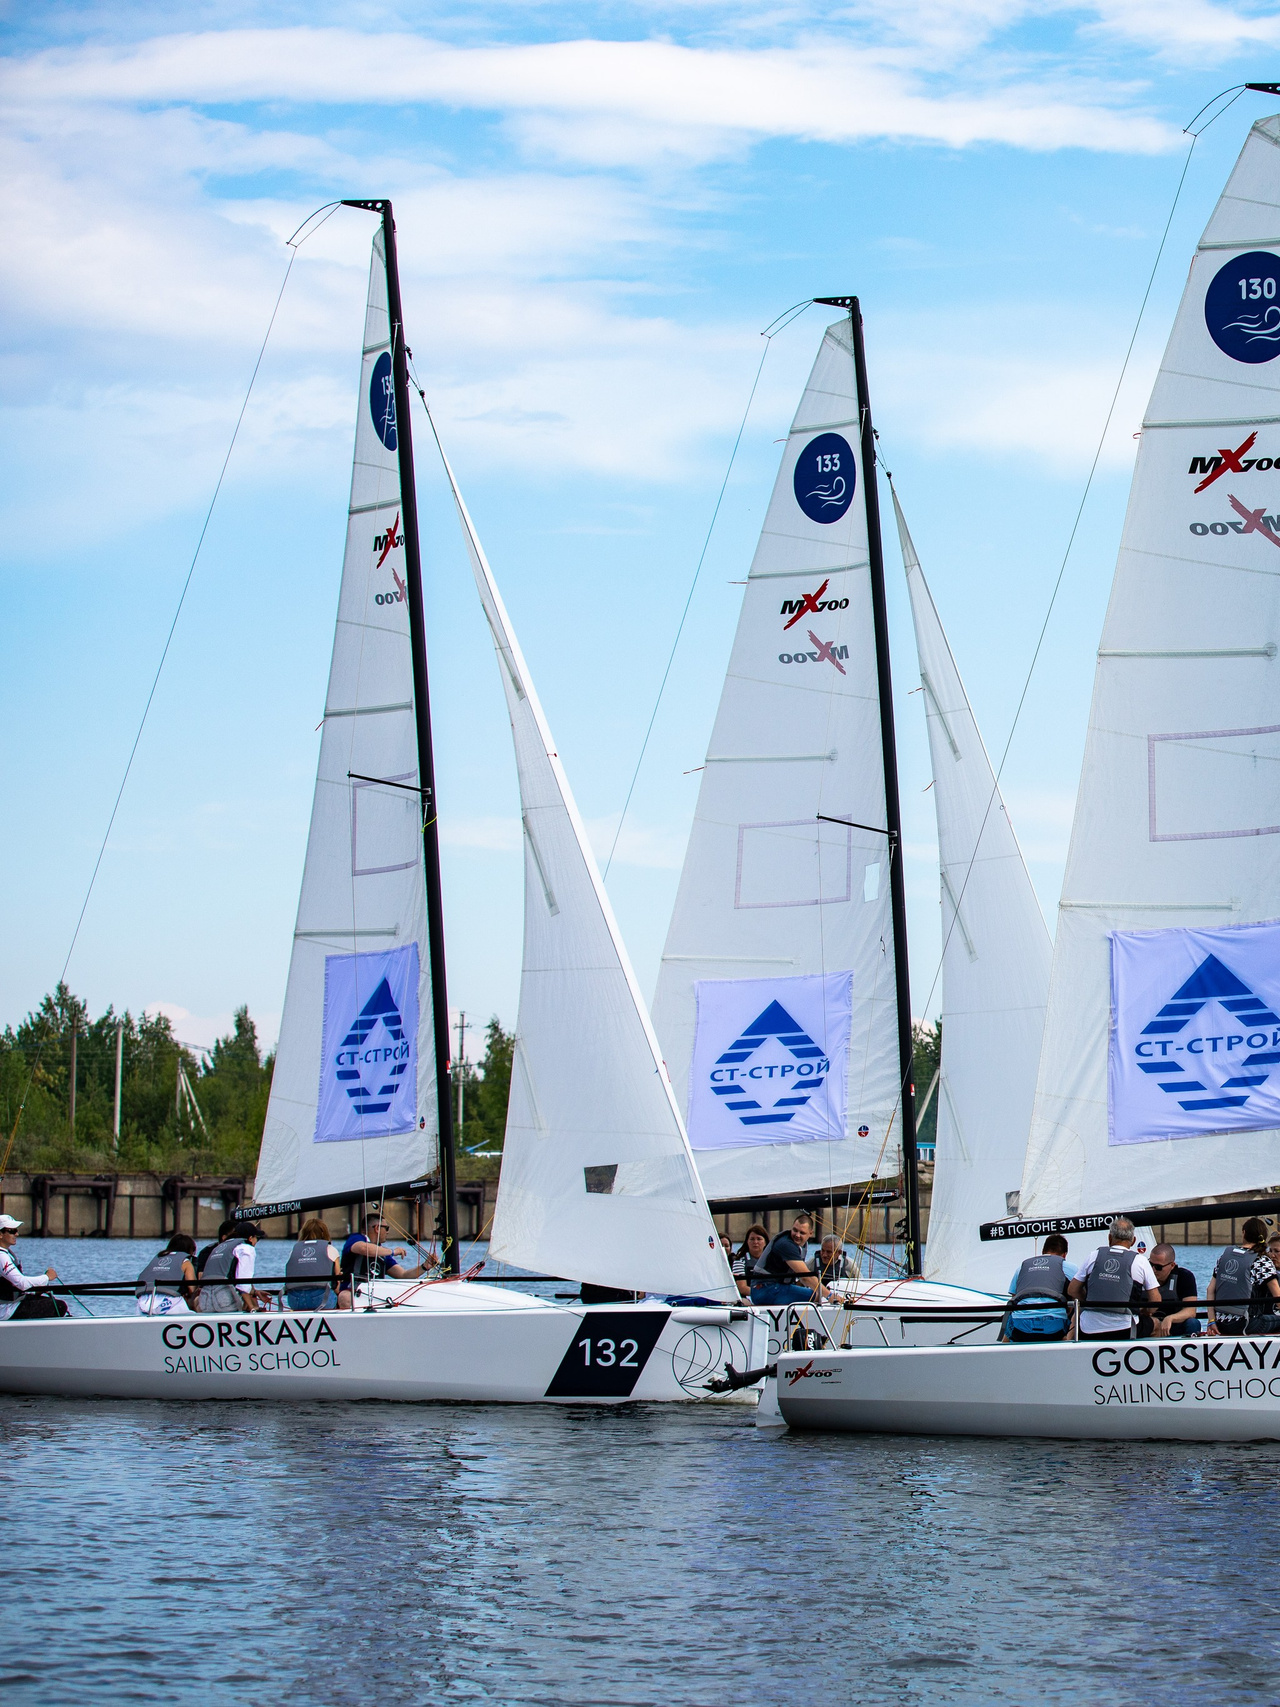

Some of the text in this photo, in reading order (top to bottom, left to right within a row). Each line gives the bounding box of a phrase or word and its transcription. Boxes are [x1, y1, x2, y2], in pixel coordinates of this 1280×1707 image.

[1238, 277, 1276, 300] 130
[816, 453, 840, 473] 133
[373, 511, 405, 569] MX70
[780, 579, 850, 630] MX700
[335, 1041, 410, 1066] СТ-СТРОЙ
[709, 1057, 830, 1082] СТ-СТРОЙ
[243, 1206, 268, 1218] ПОГОНЕ
[268, 1205, 277, 1215] ЗА
[277, 1201, 302, 1213] ВЕТРОМ
[989, 1226, 1005, 1238] #В
[1007, 1220, 1056, 1236] ПОГОНЕ
[1059, 1219, 1075, 1232] ЗА
[162, 1317, 337, 1349] GORSKAYA
[165, 1349, 341, 1374] SAILING SCHOOL
[578, 1338, 639, 1367] 132
[785, 1360, 833, 1386] MX700
[1094, 1381, 1186, 1405] SAILING
